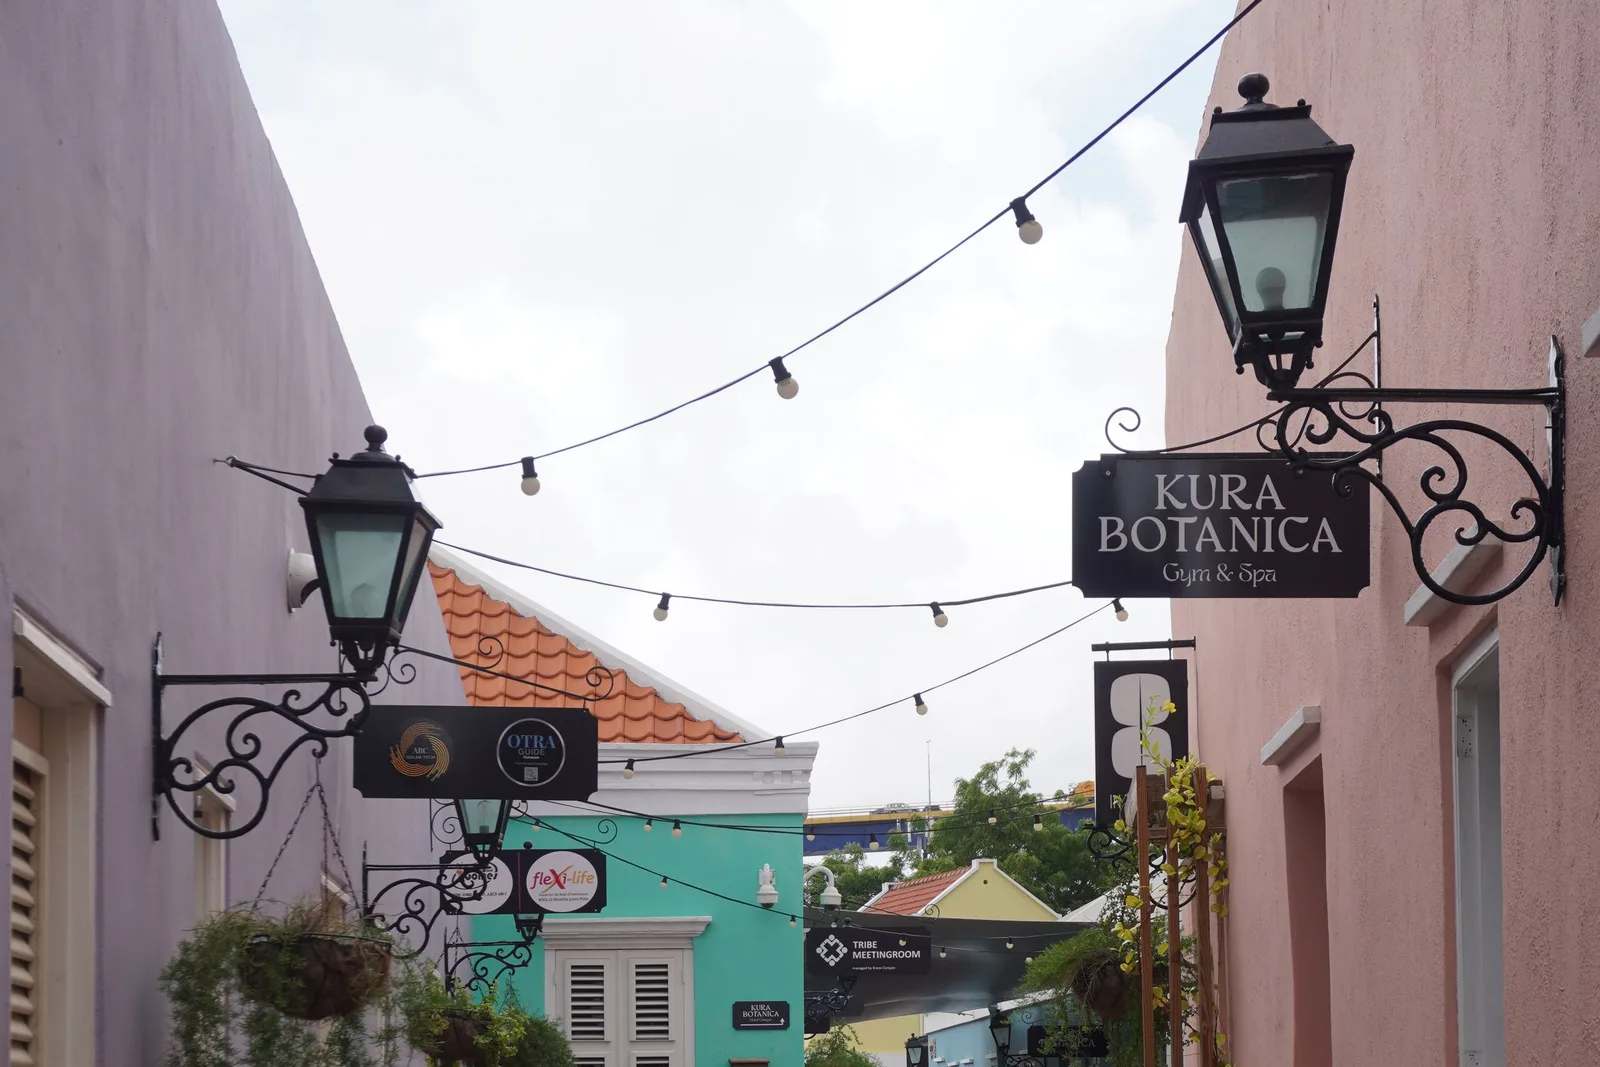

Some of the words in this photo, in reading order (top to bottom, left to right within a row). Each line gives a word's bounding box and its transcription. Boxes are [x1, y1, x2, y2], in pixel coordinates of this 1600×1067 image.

[1154, 474, 1286, 510] KURA
[1098, 516, 1343, 553] BOTANICA
[1163, 563, 1211, 587] Gym
[1216, 563, 1234, 582] &
[1239, 563, 1277, 588] Spa
[507, 734, 556, 749] OTRA
[517, 748, 545, 756] GUIDE
[853, 941, 877, 949] TRIBE
[852, 950, 920, 958] MEETINGROOM
